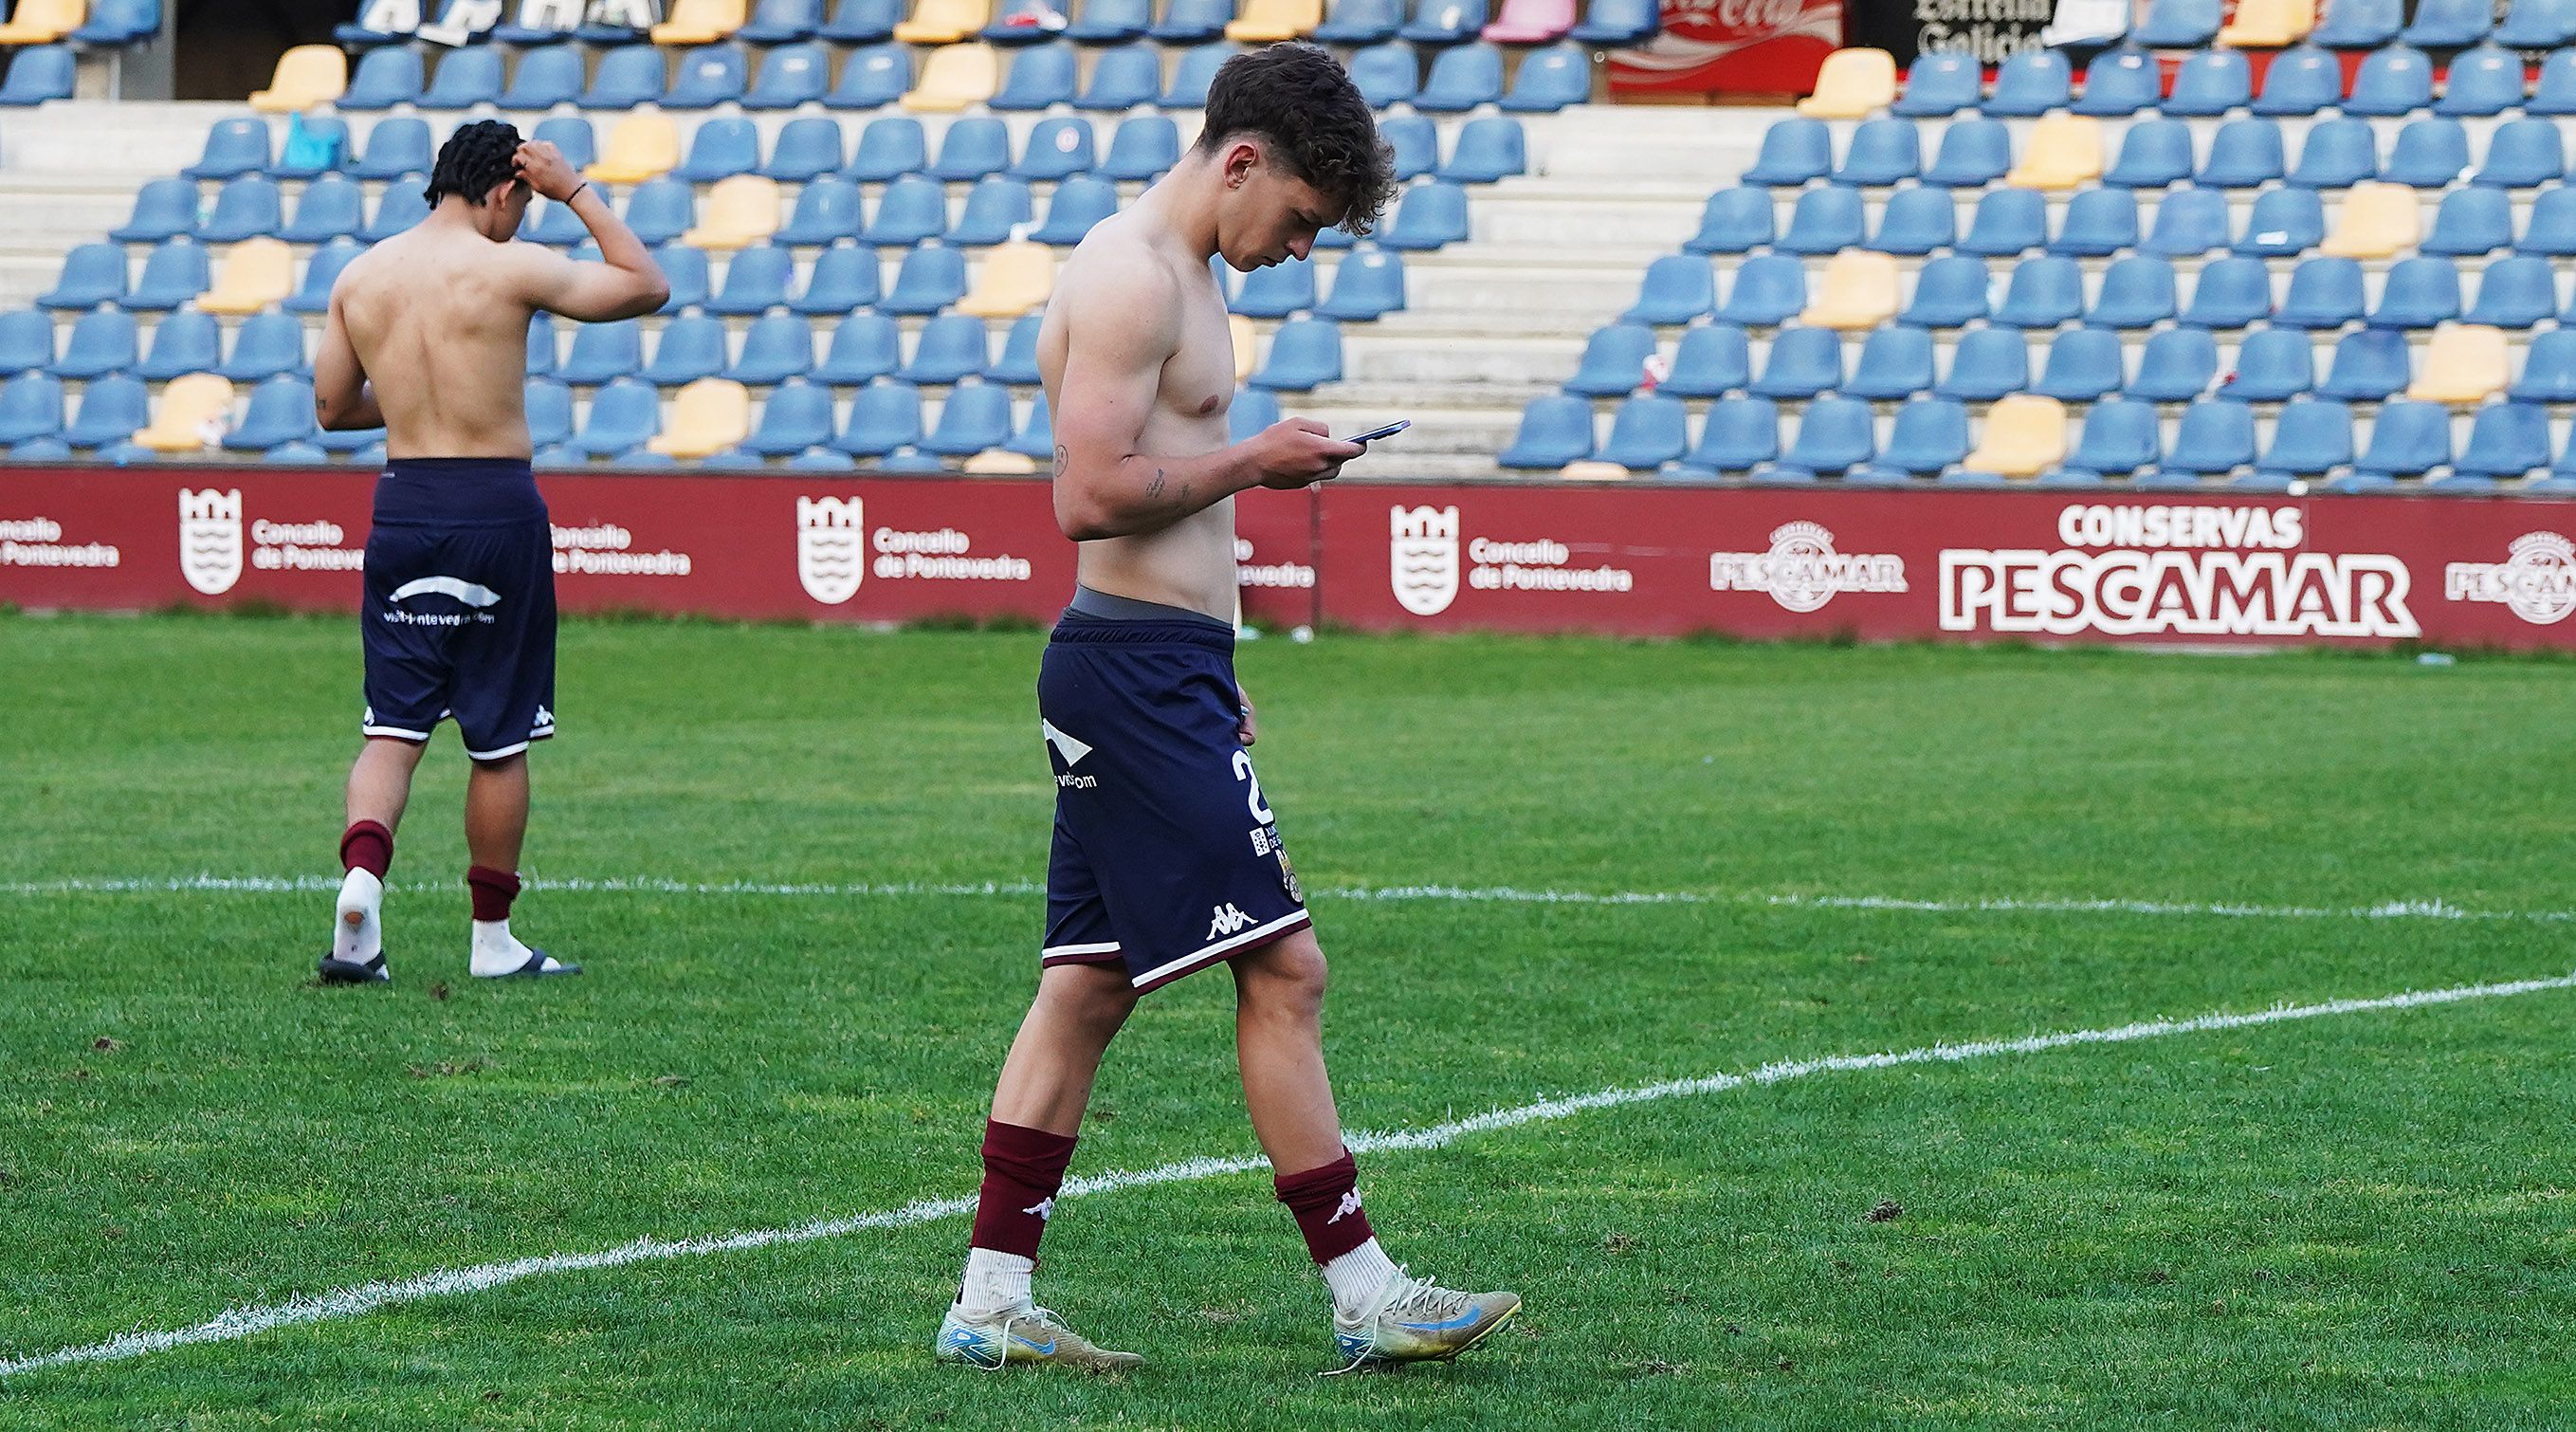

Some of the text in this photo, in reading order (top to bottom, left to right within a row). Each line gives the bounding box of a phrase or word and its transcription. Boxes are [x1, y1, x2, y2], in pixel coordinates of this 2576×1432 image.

[0, 516, 62, 542] ncello
[251, 519, 343, 545] Concello
[550, 523, 631, 550] oncello
[2058, 505, 2302, 548] CONSERVAS
[873, 527, 970, 554] Concello
[1469, 537, 1569, 565] Concello
[251, 543, 365, 571] de Ponteve
[569, 549, 691, 576] Pontevedra
[873, 553, 1032, 580] de Pontevedra
[1236, 561, 1316, 588] evedra
[1469, 564, 1633, 592] de Pontevedra
[1710, 552, 1909, 593] PESCAMAR
[1939, 549, 2421, 637] PESCAMAR
